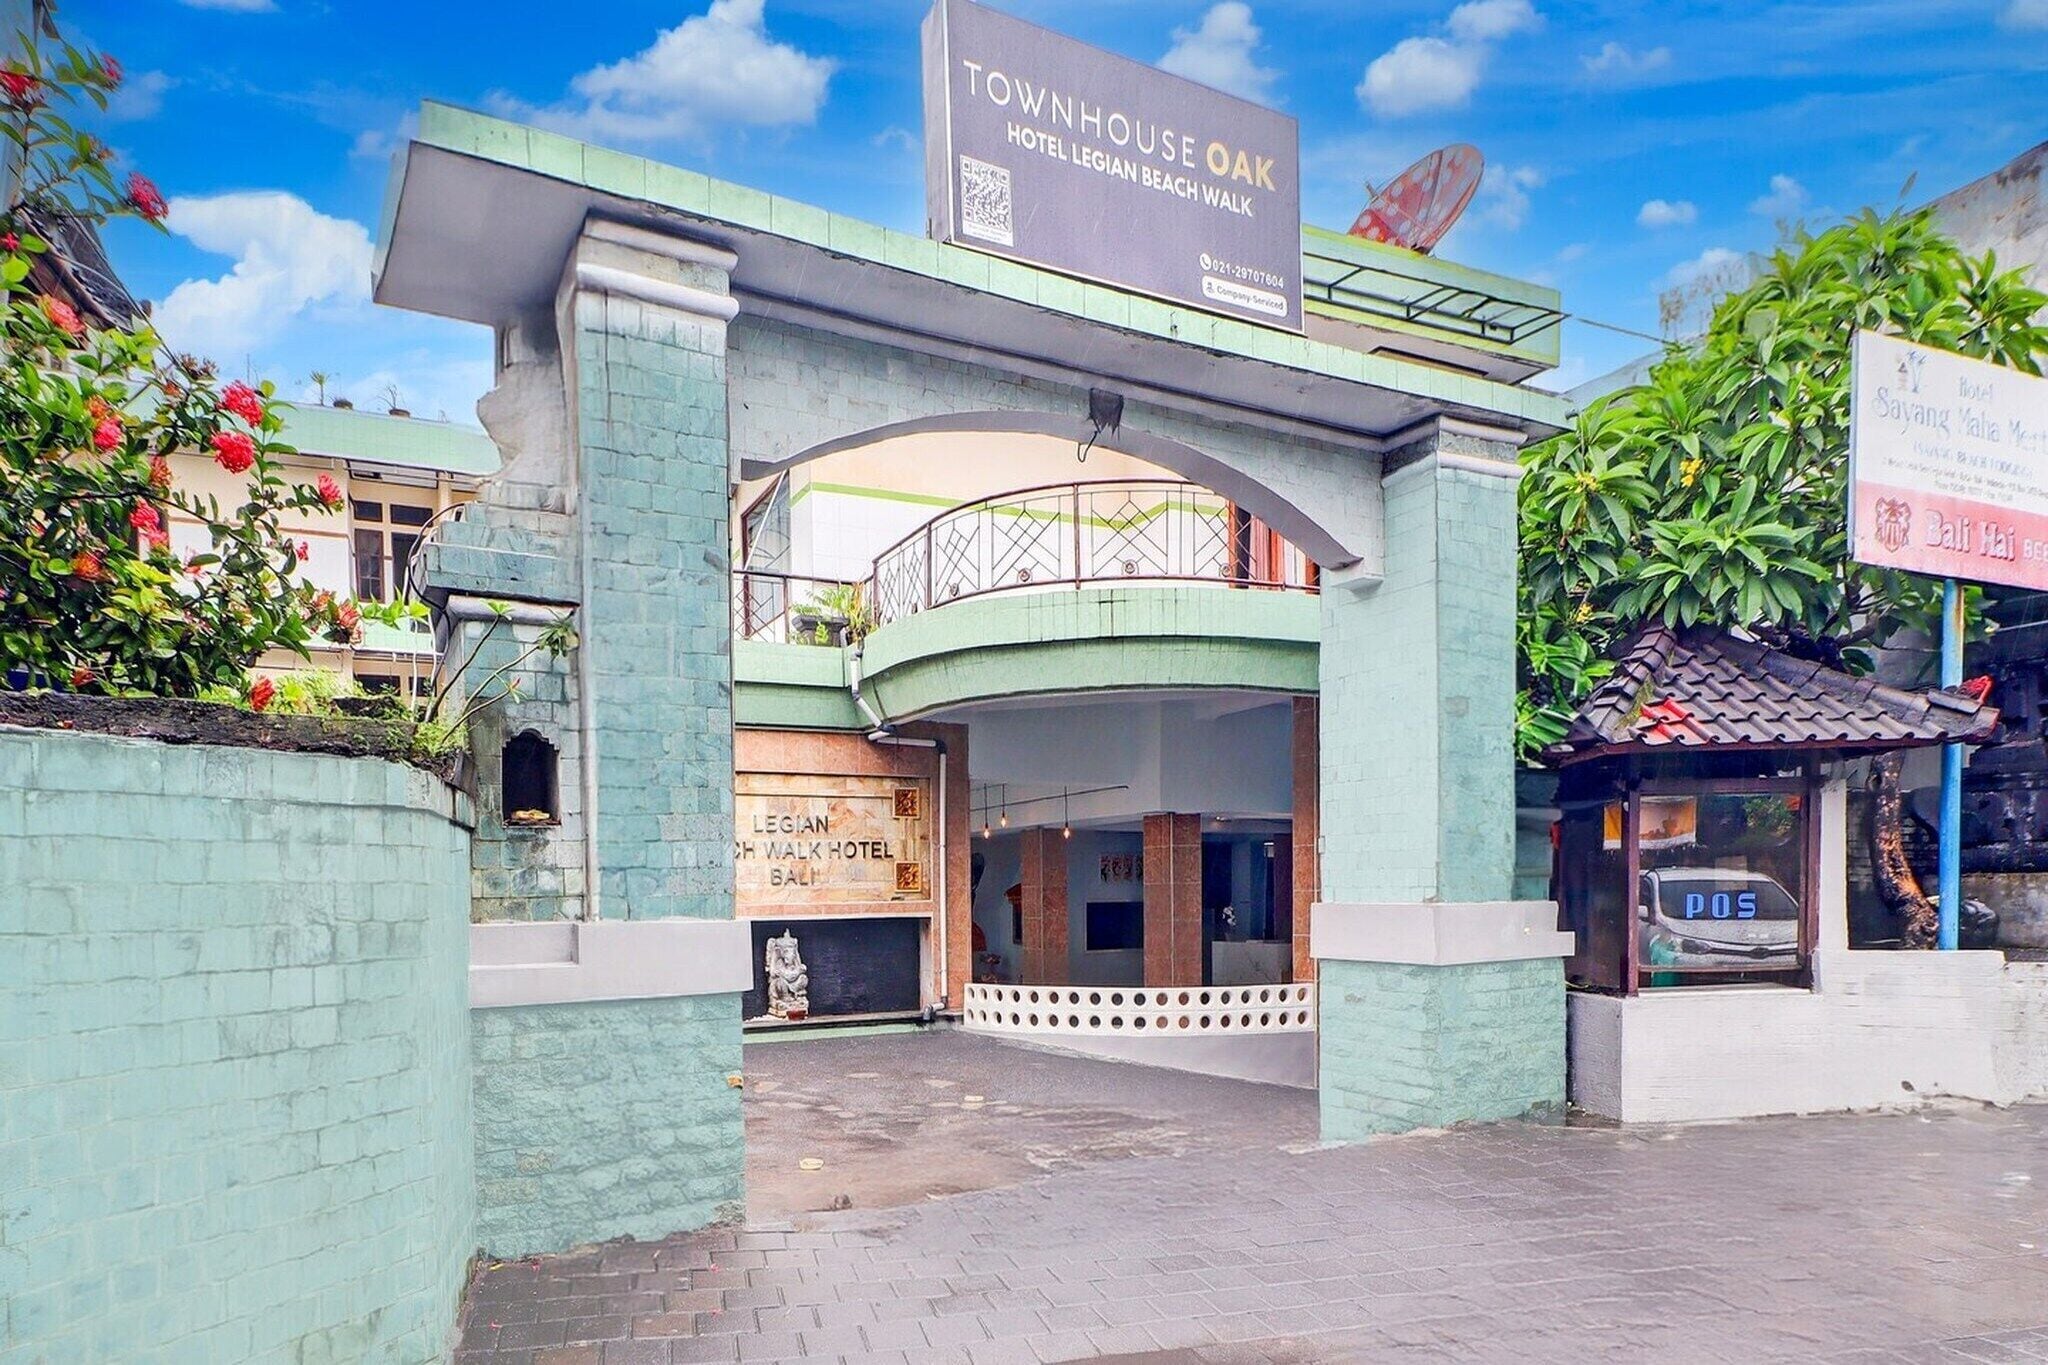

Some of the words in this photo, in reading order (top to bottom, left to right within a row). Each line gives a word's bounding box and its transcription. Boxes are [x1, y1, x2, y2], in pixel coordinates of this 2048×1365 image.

[963, 60, 1196, 169] TOWNHOUSE
[1206, 142, 1276, 192] OAK
[1007, 121, 1067, 161] HOTEL
[1072, 143, 1137, 183] LEGIAN
[1142, 166, 1198, 202] BEACH
[1202, 183, 1253, 217] WALK
[1212, 259, 1284, 289] 021-29707604
[1959, 375, 1993, 401] Hotel
[1871, 386, 1950, 439] Sayang
[1925, 508, 1970, 553] Bali
[1979, 521, 2015, 562] Hai
[753, 815, 829, 834] LEGIAN
[764, 841, 822, 860] WALK
[828, 841, 894, 860] HOTEL
[770, 867, 818, 887] BALI
[1686, 892, 1756, 919] POS
